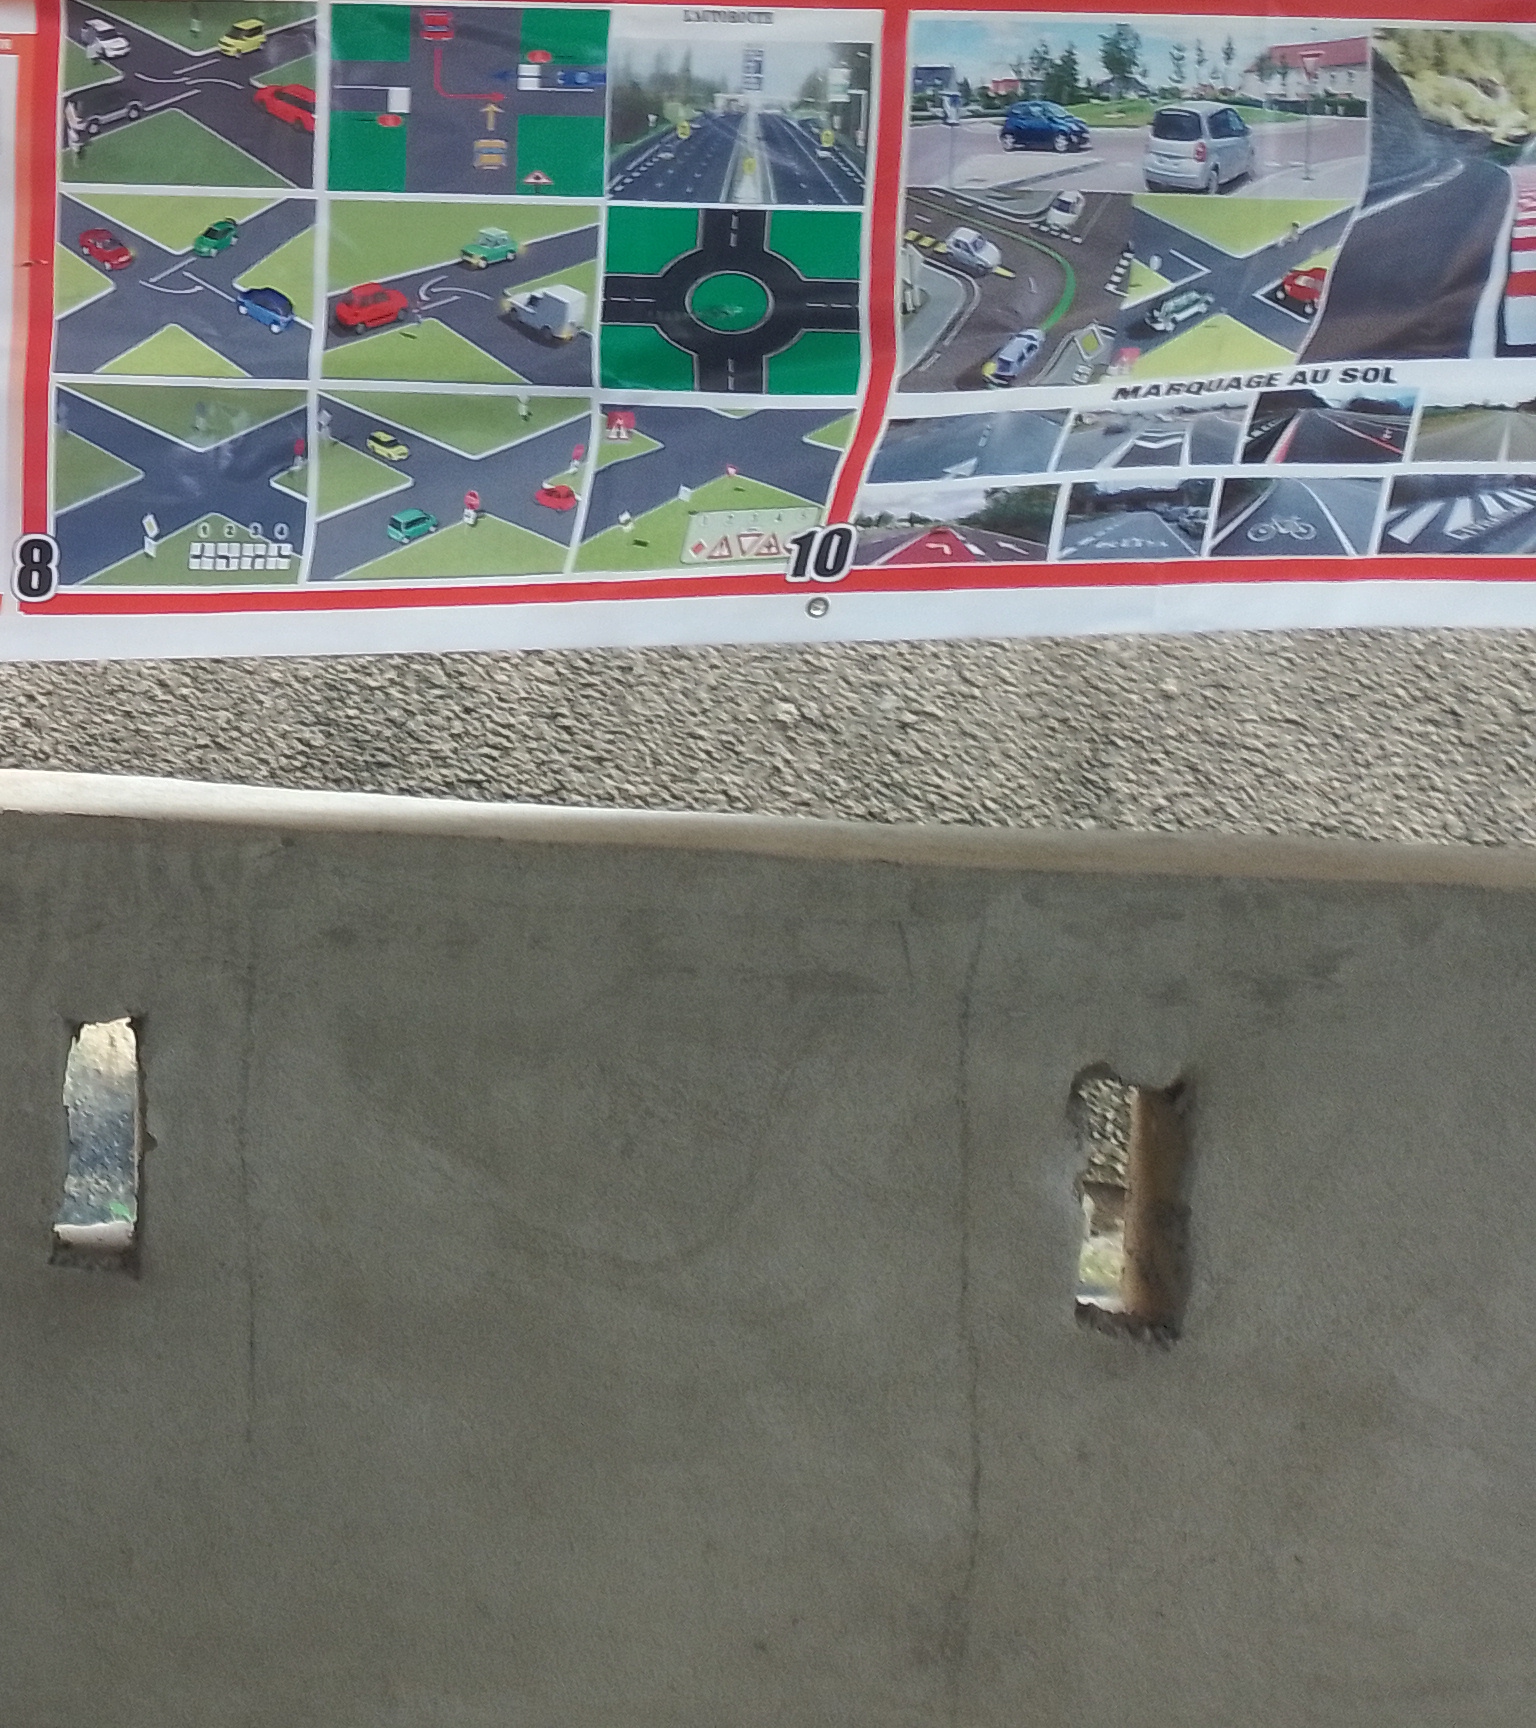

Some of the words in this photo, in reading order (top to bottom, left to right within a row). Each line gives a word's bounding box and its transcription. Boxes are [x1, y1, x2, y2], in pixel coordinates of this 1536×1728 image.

[1111, 372, 1284, 402] MARQUAGE
[1288, 368, 1332, 386] AU
[1338, 365, 1398, 385] SOL
[18, 540, 55, 597] 8
[788, 526, 853, 581] 10
